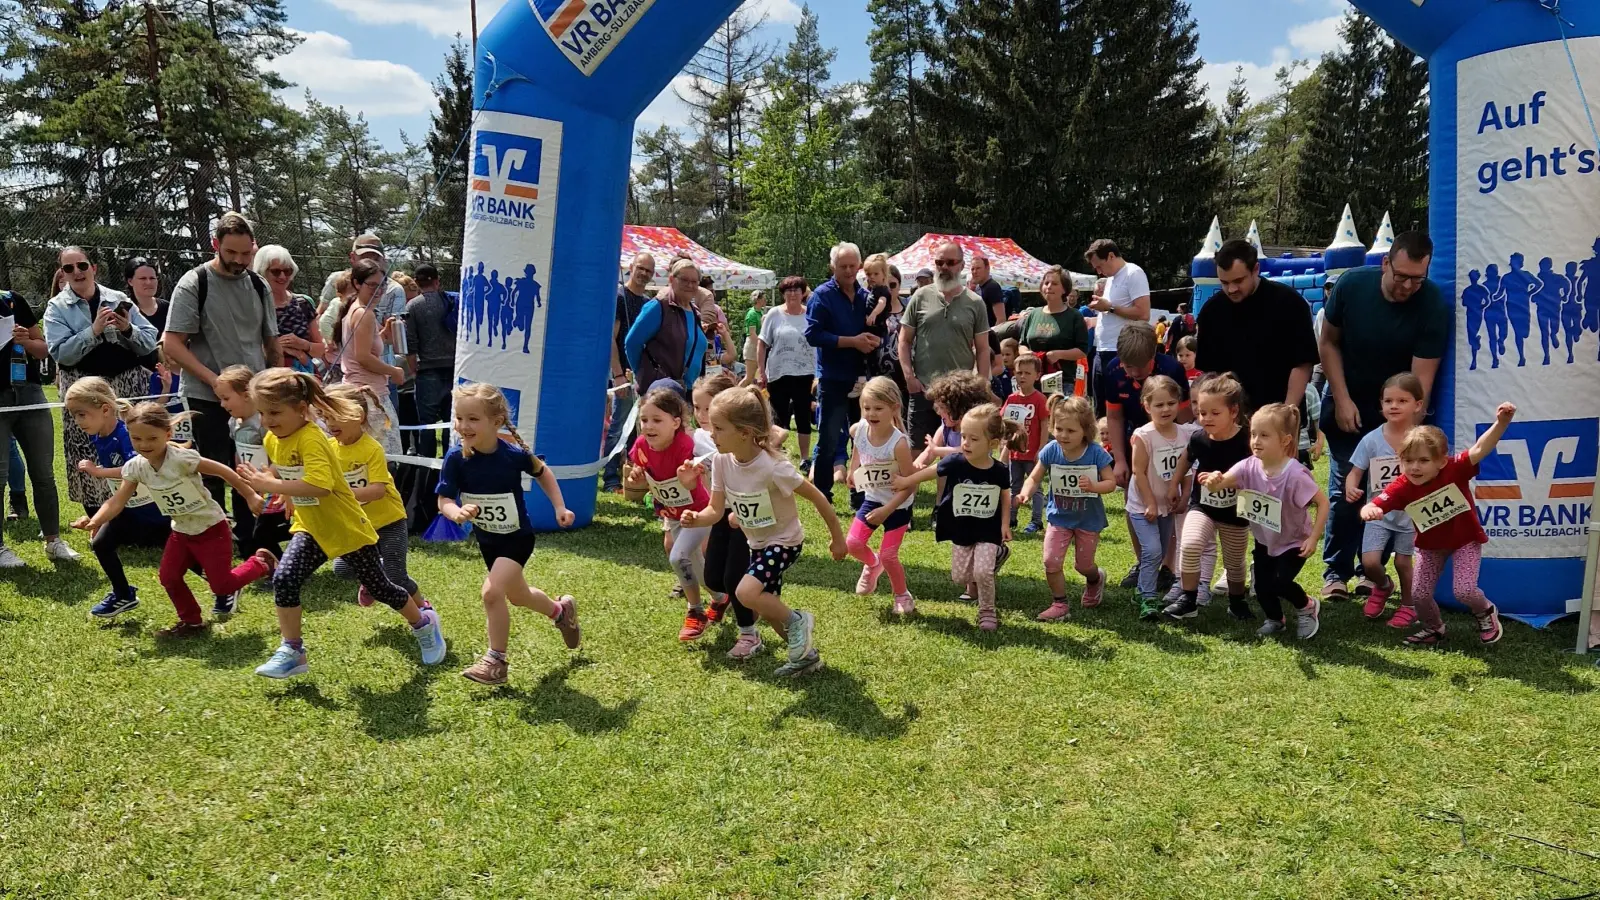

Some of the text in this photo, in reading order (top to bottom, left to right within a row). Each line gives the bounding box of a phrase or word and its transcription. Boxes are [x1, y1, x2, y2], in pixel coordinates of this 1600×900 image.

[561, 20, 599, 56] VR
[1477, 91, 1547, 134] Auf
[487, 197, 536, 221] BANK
[524, 221, 535, 230] EG
[863, 469, 890, 481] 175
[1060, 474, 1082, 487] 19
[162, 491, 185, 507] 35
[962, 493, 991, 508] 274
[1421, 495, 1455, 518] 144
[475, 505, 508, 521] 253
[733, 501, 759, 518] 197
[1252, 500, 1270, 516] 91
[1475, 502, 1592, 526] VR BANK
